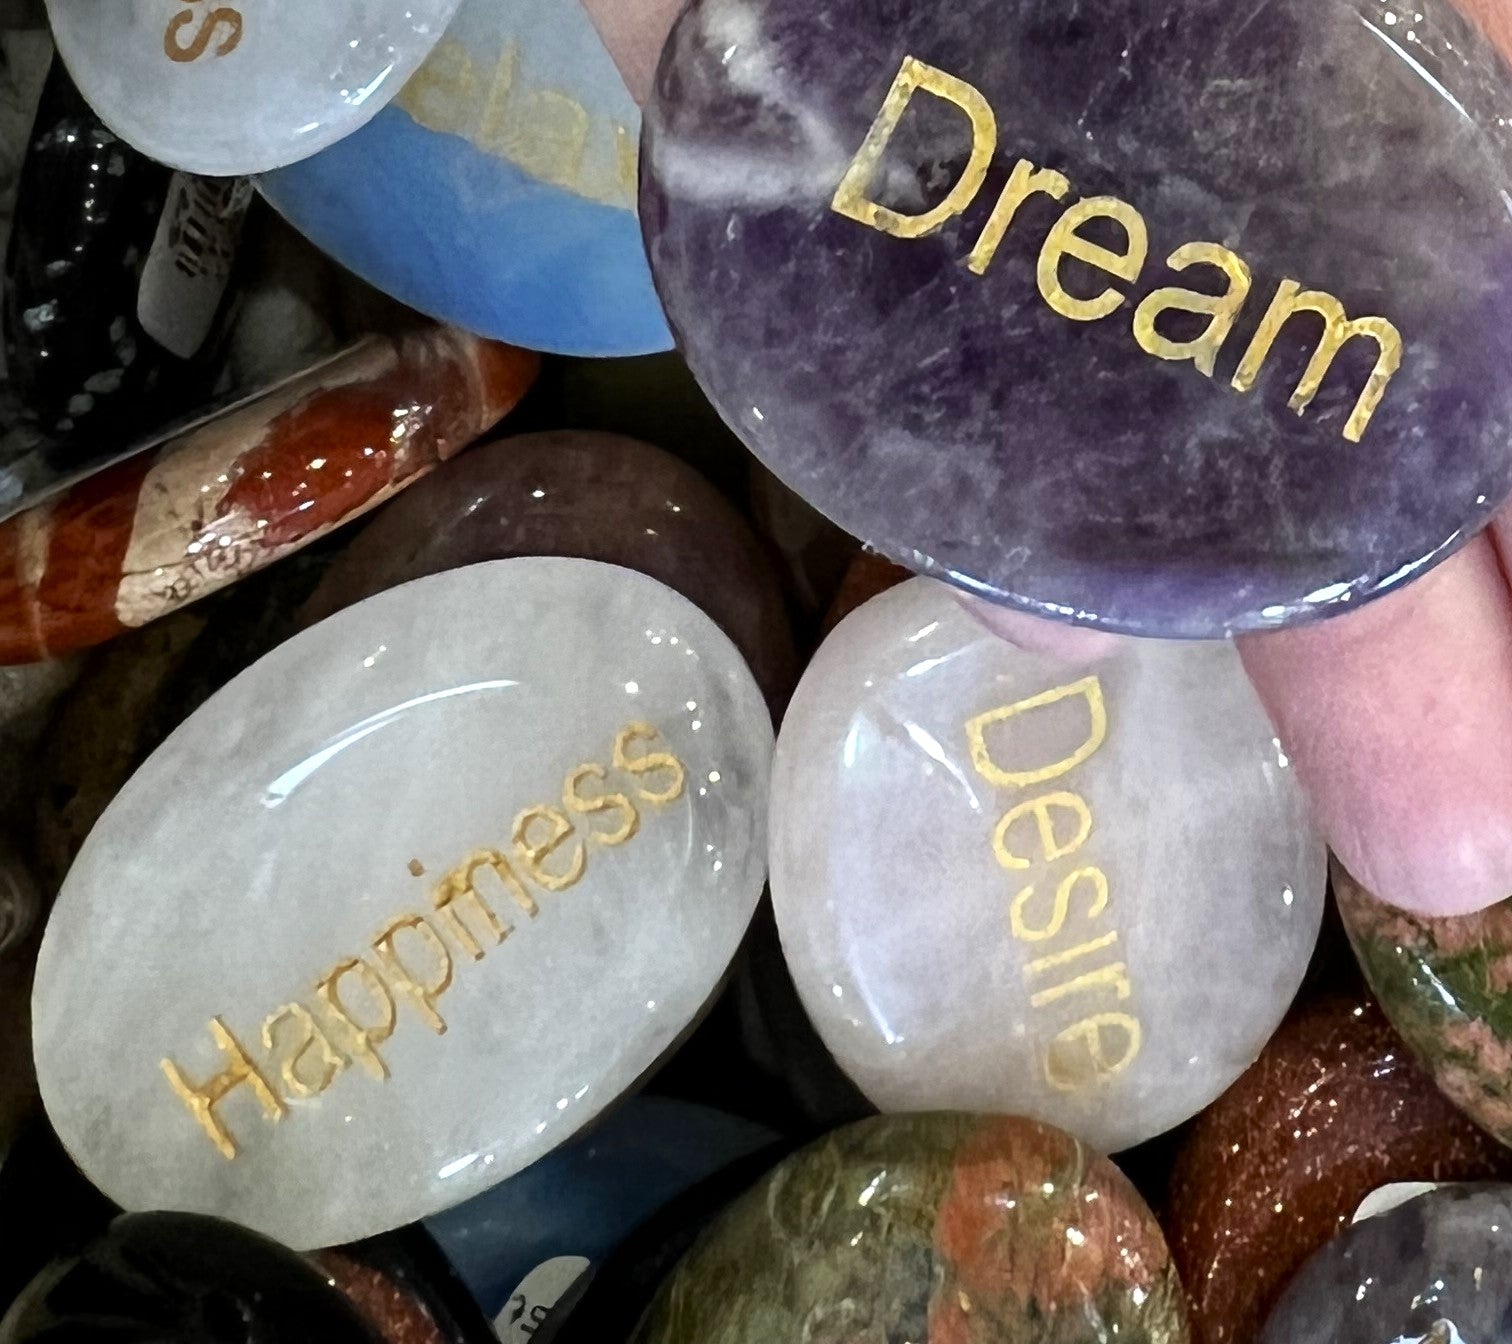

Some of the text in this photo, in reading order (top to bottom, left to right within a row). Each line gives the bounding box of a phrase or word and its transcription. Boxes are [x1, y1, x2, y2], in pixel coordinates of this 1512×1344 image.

[830, 54, 1403, 444] Dream
[159, 721, 688, 1161] Happiness
[964, 674, 1142, 1092] Desire
